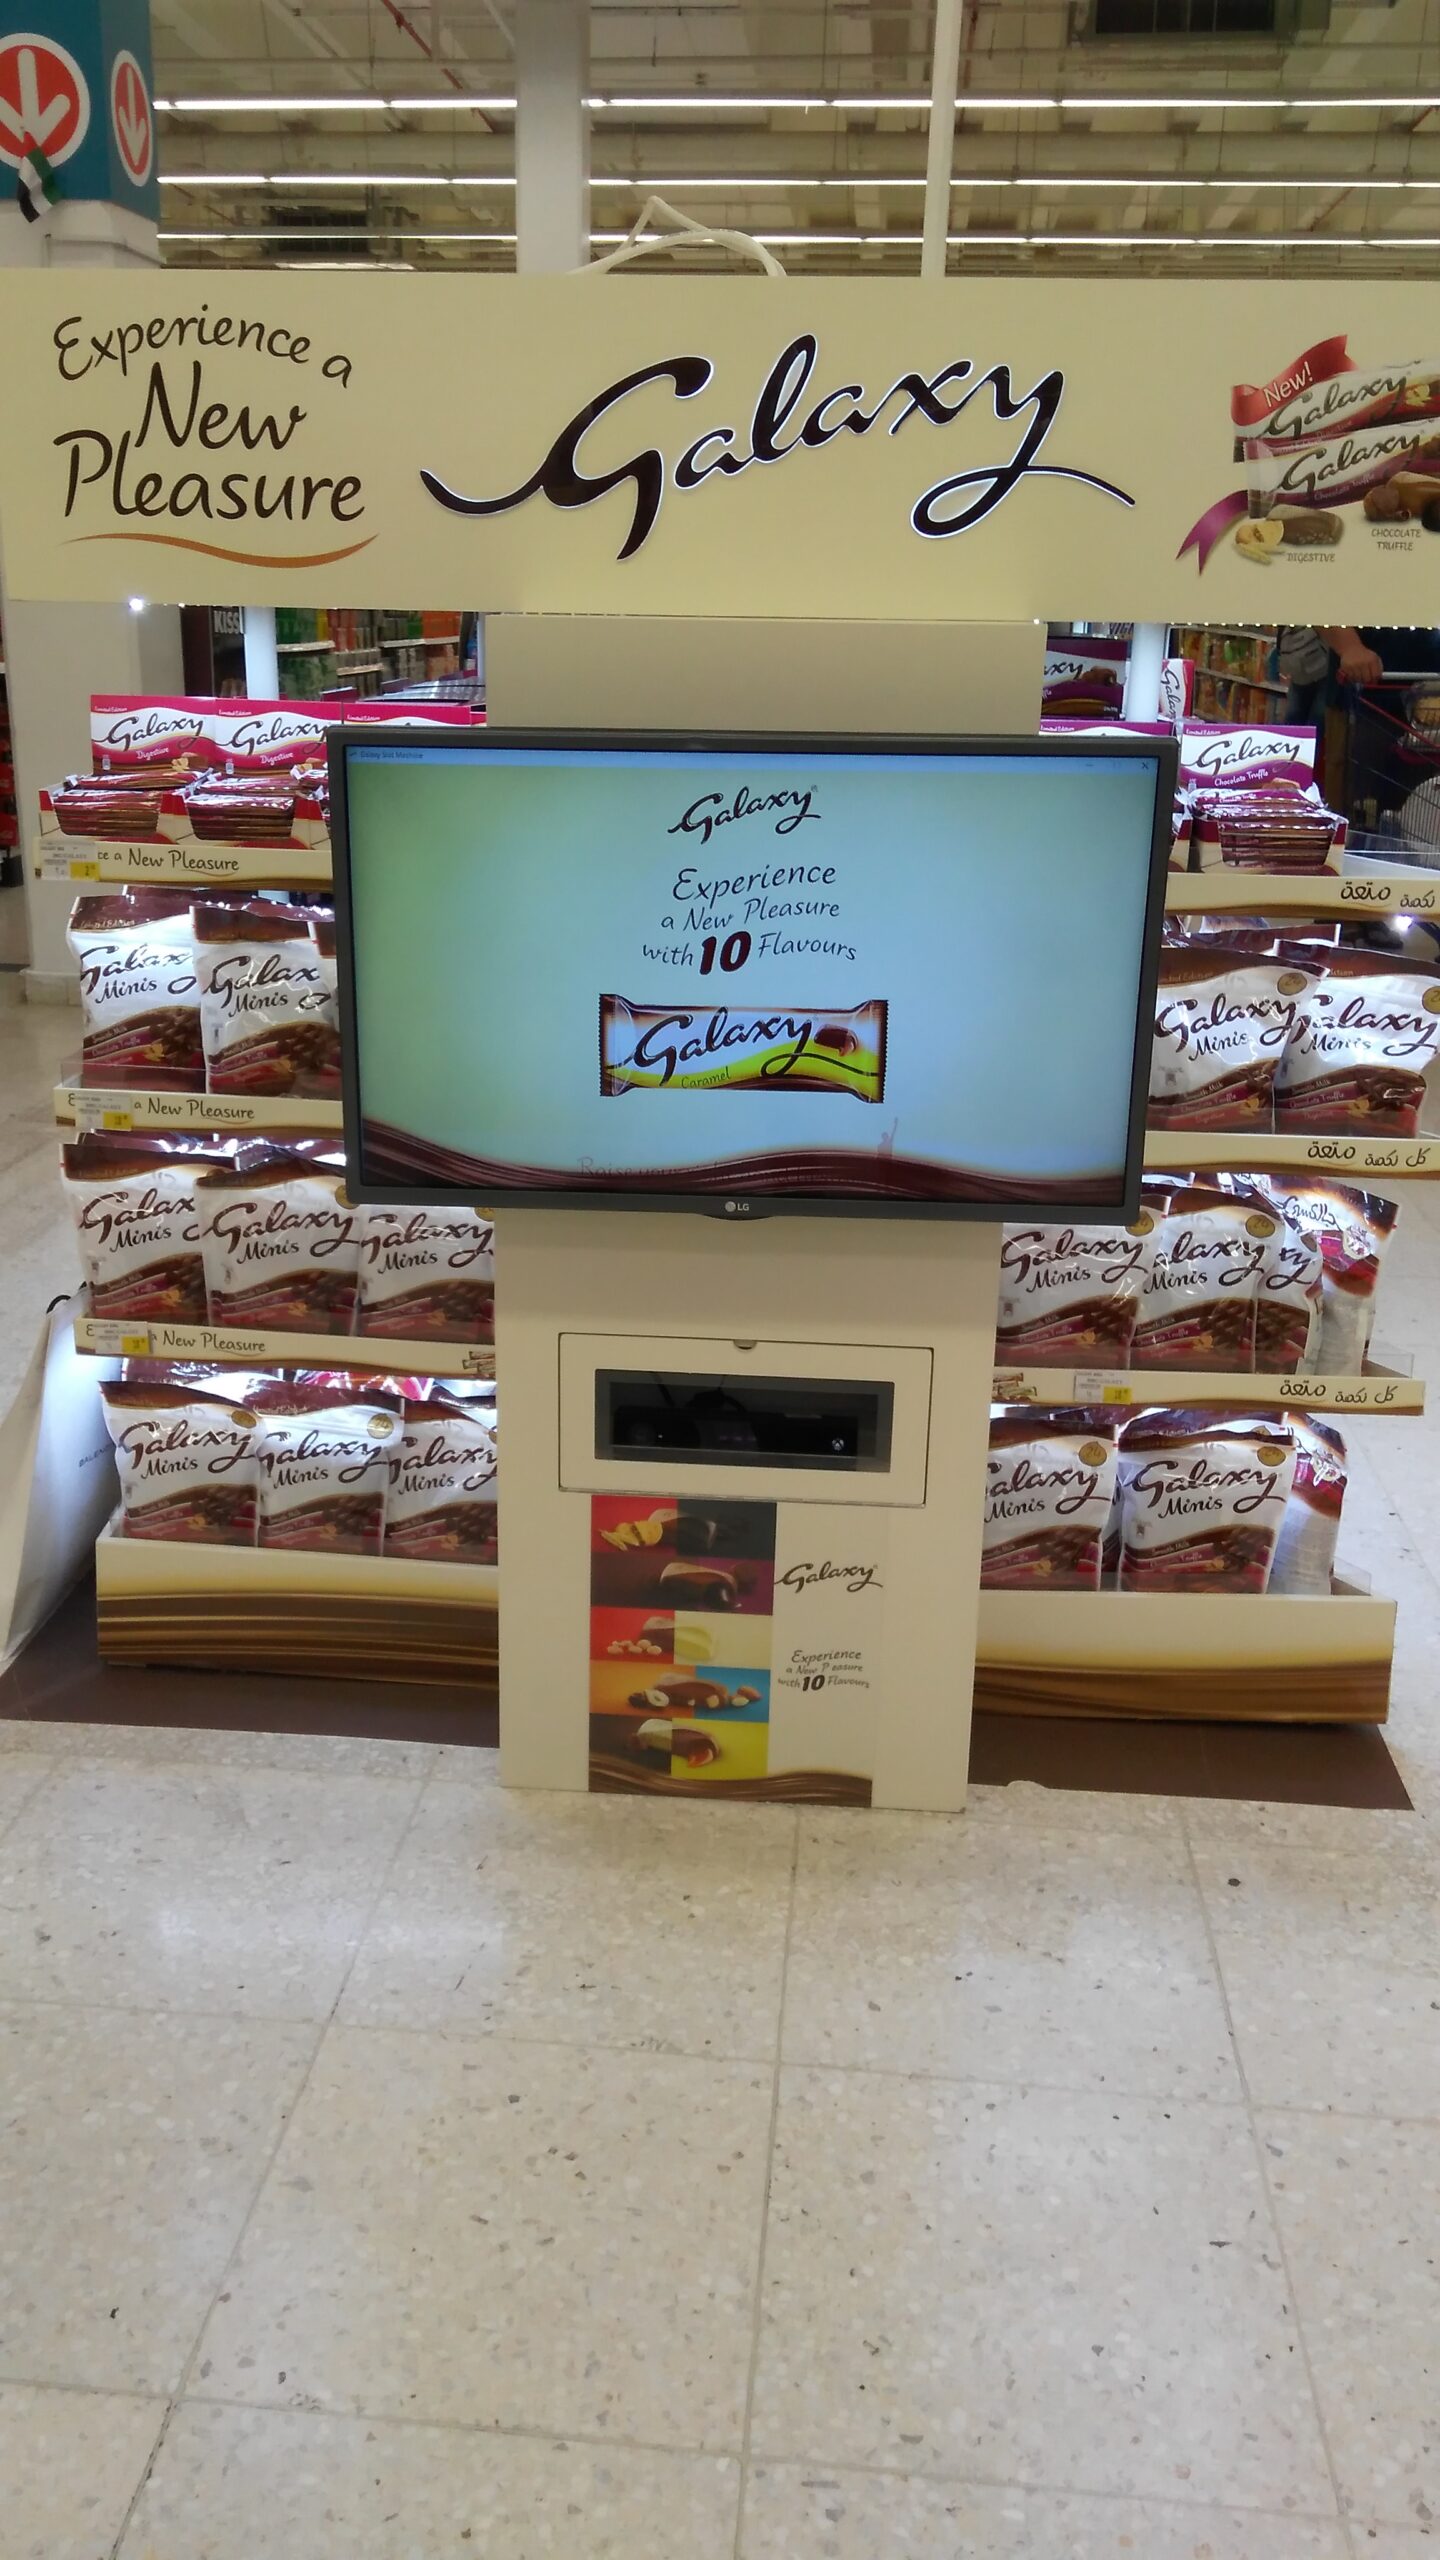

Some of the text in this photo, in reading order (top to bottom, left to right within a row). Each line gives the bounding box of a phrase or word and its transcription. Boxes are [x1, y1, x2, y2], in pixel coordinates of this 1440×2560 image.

[53, 303, 353, 388] Experience a
[1263, 361, 1314, 408] New!
[134, 360, 307, 451] New
[1262, 374, 1408, 440] Galaxy
[419, 334, 1136, 561] Galaxy
[53, 430, 366, 522] Pleasure
[1272, 433, 1421, 494] Galaxy
[1371, 529, 1421, 538] CHOCOLATE
[1287, 552, 1335, 562] DIGESTIVE
[1377, 541, 1414, 552] TRUFFLE
[93, 713, 204, 751] Galaxy
[136, 746, 169, 761] Digestive
[260, 751, 294, 765] Digestive
[1183, 737, 1301, 776] Galaxy
[1214, 768, 1269, 787] Chocolate Truffle
[667, 786, 821, 844] Galaxy
[114, 852, 122, 861] a
[128, 848, 165, 867] New
[168, 850, 240, 871] Pleasure
[672, 864, 836, 909] Experience
[1341, 881, 1391, 901] متعة
[660, 896, 840, 931] a New Pleasure
[642, 930, 857, 976] with 10 Flavours
[96, 977, 157, 1004] Minis
[228, 992, 289, 1018] Minis
[1154, 993, 1297, 1053] Galaxy
[612, 1006, 870, 1087] Galaxy
[1188, 1031, 1248, 1061] Minis
[1301, 1033, 1371, 1055] Minis
[681, 1066, 731, 1090] Caramel
[135, 1101, 142, 1109] a
[148, 1099, 182, 1116] New
[187, 1100, 255, 1120] Pleasure
[1308, 1141, 1356, 1159] متعة
[1405, 1147, 1431, 1167] كل
[737, 1203, 749, 1211] LG
[110, 1226, 172, 1252] Minis
[202, 1200, 359, 1257] Galaxy
[361, 1213, 493, 1268] Galaxy
[237, 1239, 300, 1264] Minis
[378, 1250, 438, 1274] Minis
[1001, 1228, 1149, 1284] Galaxy
[1152, 1231, 1264, 1287] alaxy
[1026, 1266, 1091, 1293] Minis
[1143, 1271, 1208, 1294] Minis
[163, 1331, 195, 1347] New
[200, 1332, 266, 1352] Pleasure
[1280, 1379, 1327, 1397] متعة
[1374, 1385, 1399, 1404] كل
[118, 1419, 255, 1473] Galaxy
[257, 1430, 389, 1485] Galaxy
[141, 1456, 199, 1479] Minis
[274, 1466, 328, 1489] Minis
[398, 1473, 455, 1495] Minis
[1132, 1459, 1287, 1513] Galaxy
[984, 1498, 1045, 1523] Minis
[1158, 1495, 1223, 1519] Minis
[774, 1561, 884, 1594] Galaxy
[791, 1650, 862, 1666] Experience
[796, 1665, 818, 1675] New
[777, 1674, 871, 1692] with 10 Flavours
